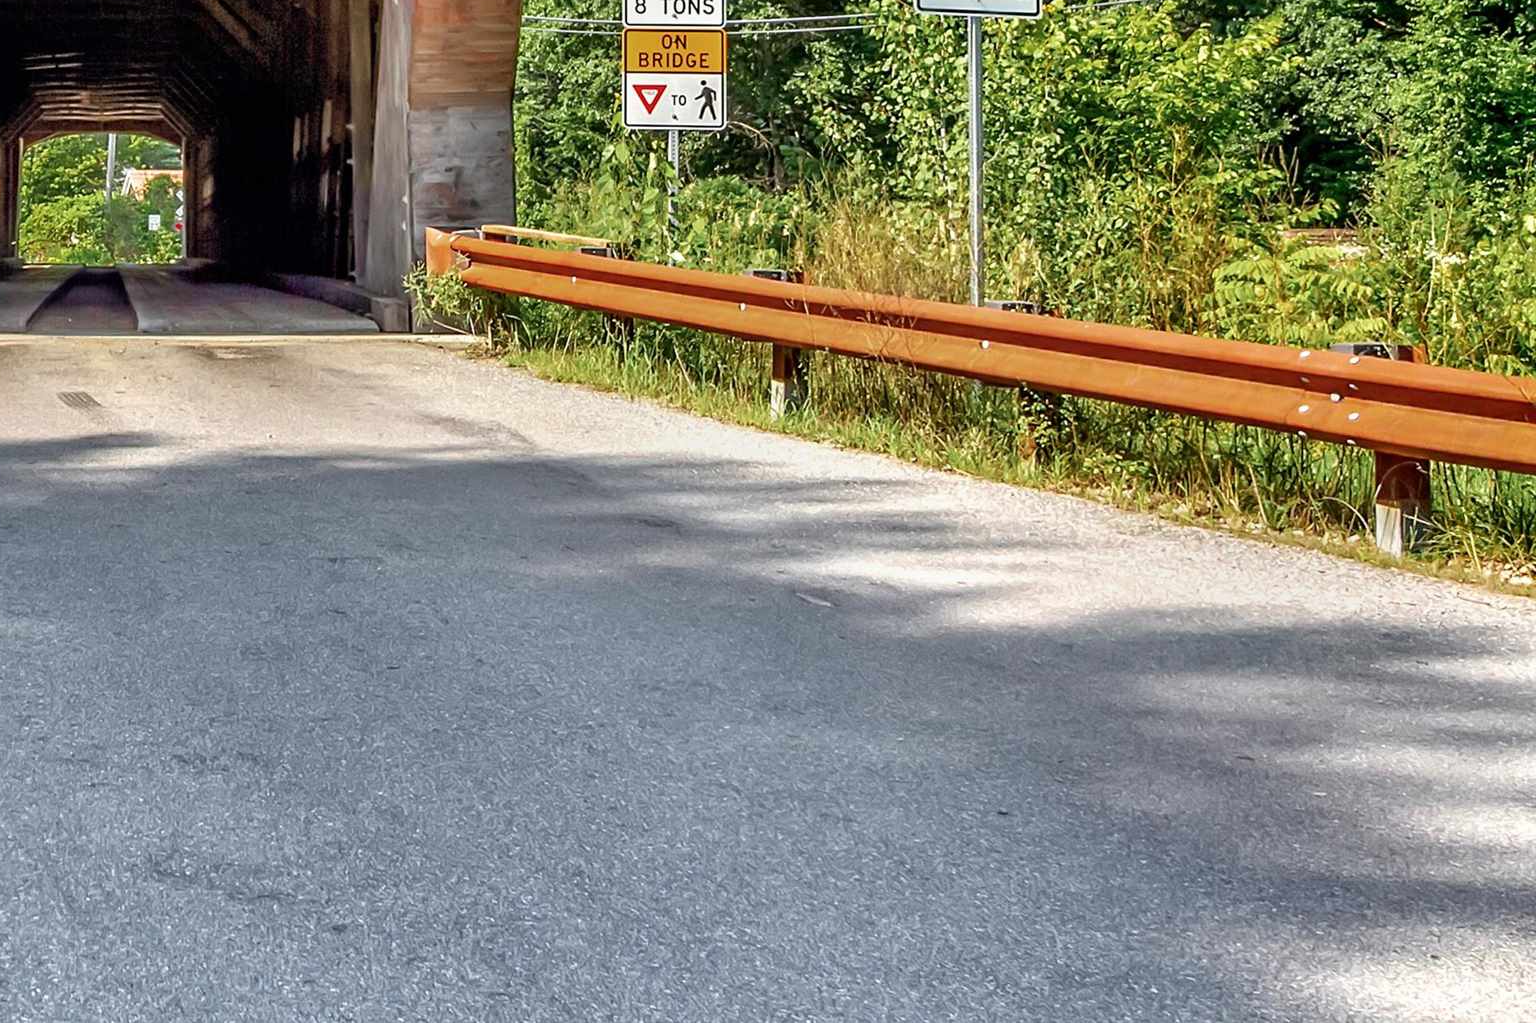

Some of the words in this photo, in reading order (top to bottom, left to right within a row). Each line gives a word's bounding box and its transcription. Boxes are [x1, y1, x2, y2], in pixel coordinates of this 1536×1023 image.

[662, 34, 687, 50] ON
[638, 53, 710, 68] BRIDGE
[671, 94, 687, 106] TO
